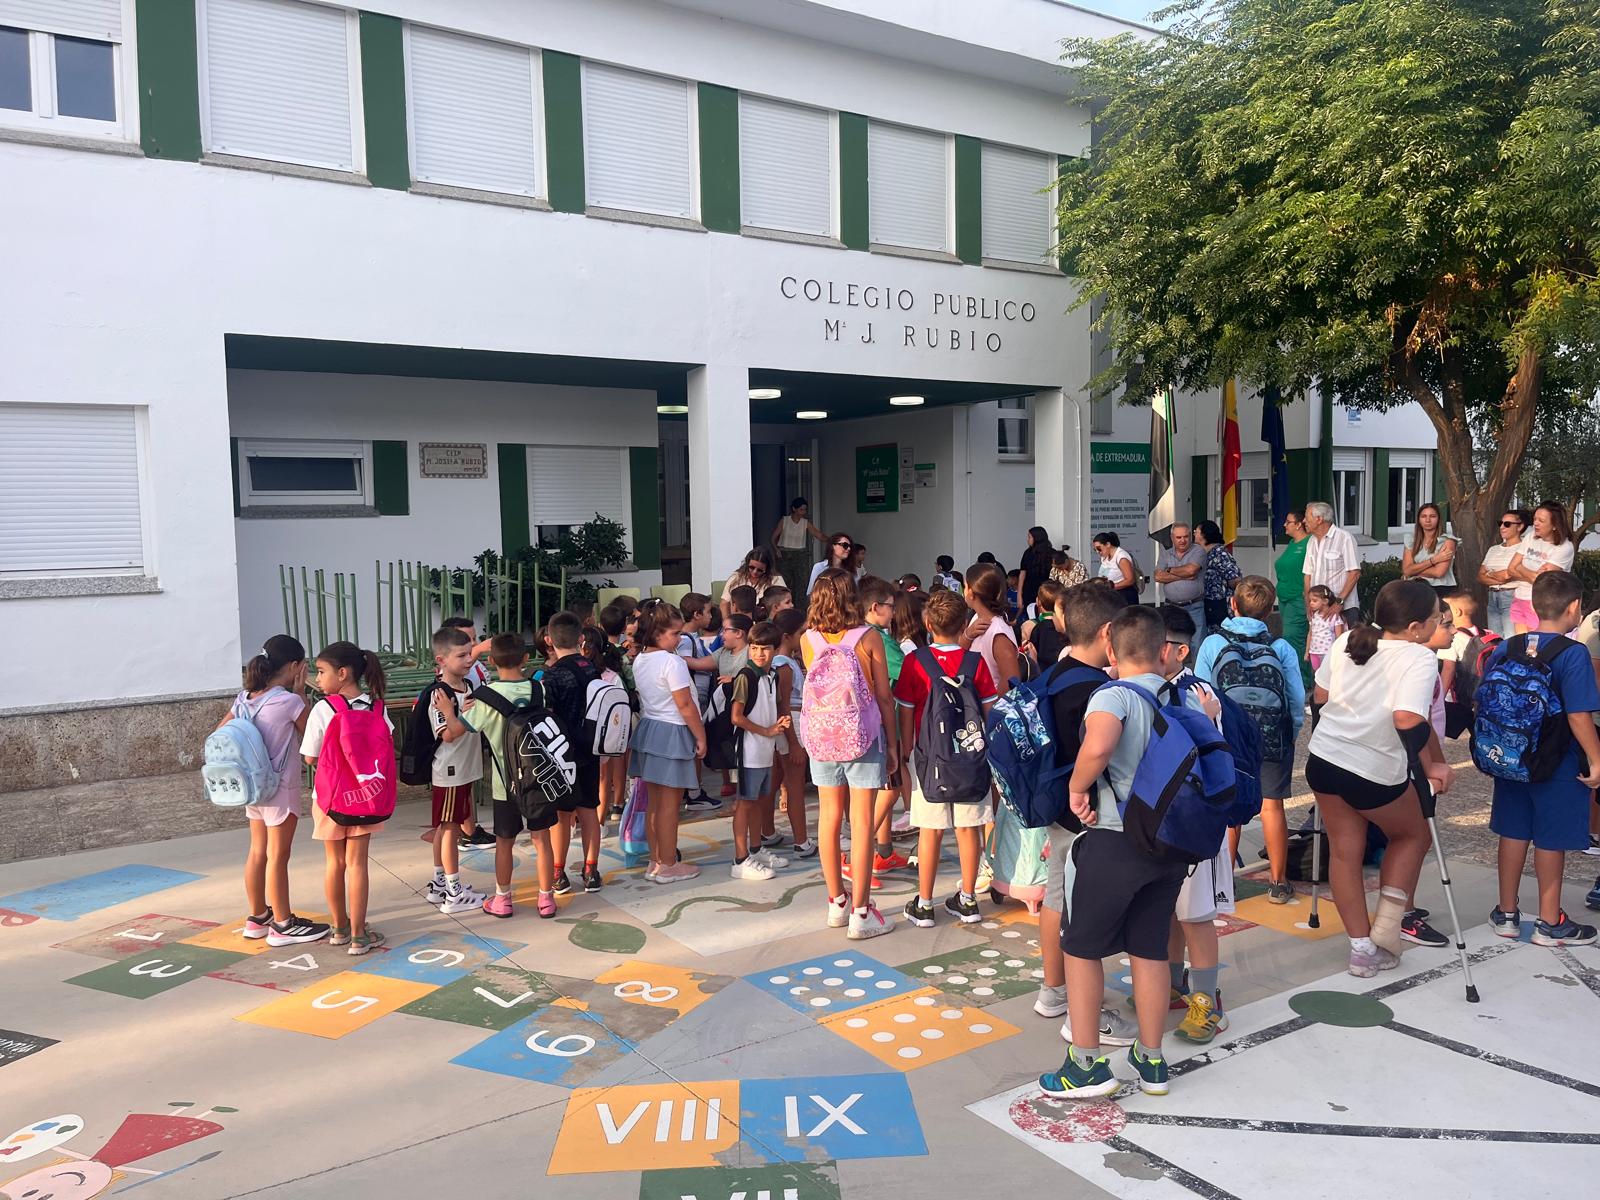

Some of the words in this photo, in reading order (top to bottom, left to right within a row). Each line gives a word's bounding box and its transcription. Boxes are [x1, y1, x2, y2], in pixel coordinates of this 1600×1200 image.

[780, 276, 914, 311] COLEGIO
[933, 293, 1036, 322] PUBLICO
[861, 323, 876, 344] J.
[903, 325, 1002, 352] RUBIO
[1096, 454, 1104, 462] DE
[1104, 453, 1146, 463] EXTREMADURA
[533, 716, 577, 785] FILA
[342, 778, 384, 807] PUMA
[128, 958, 192, 979] 3
[311, 989, 380, 1015] 5
[613, 979, 680, 1003] 8
[595, 1097, 722, 1145] VIII
[783, 1093, 869, 1138] IX
